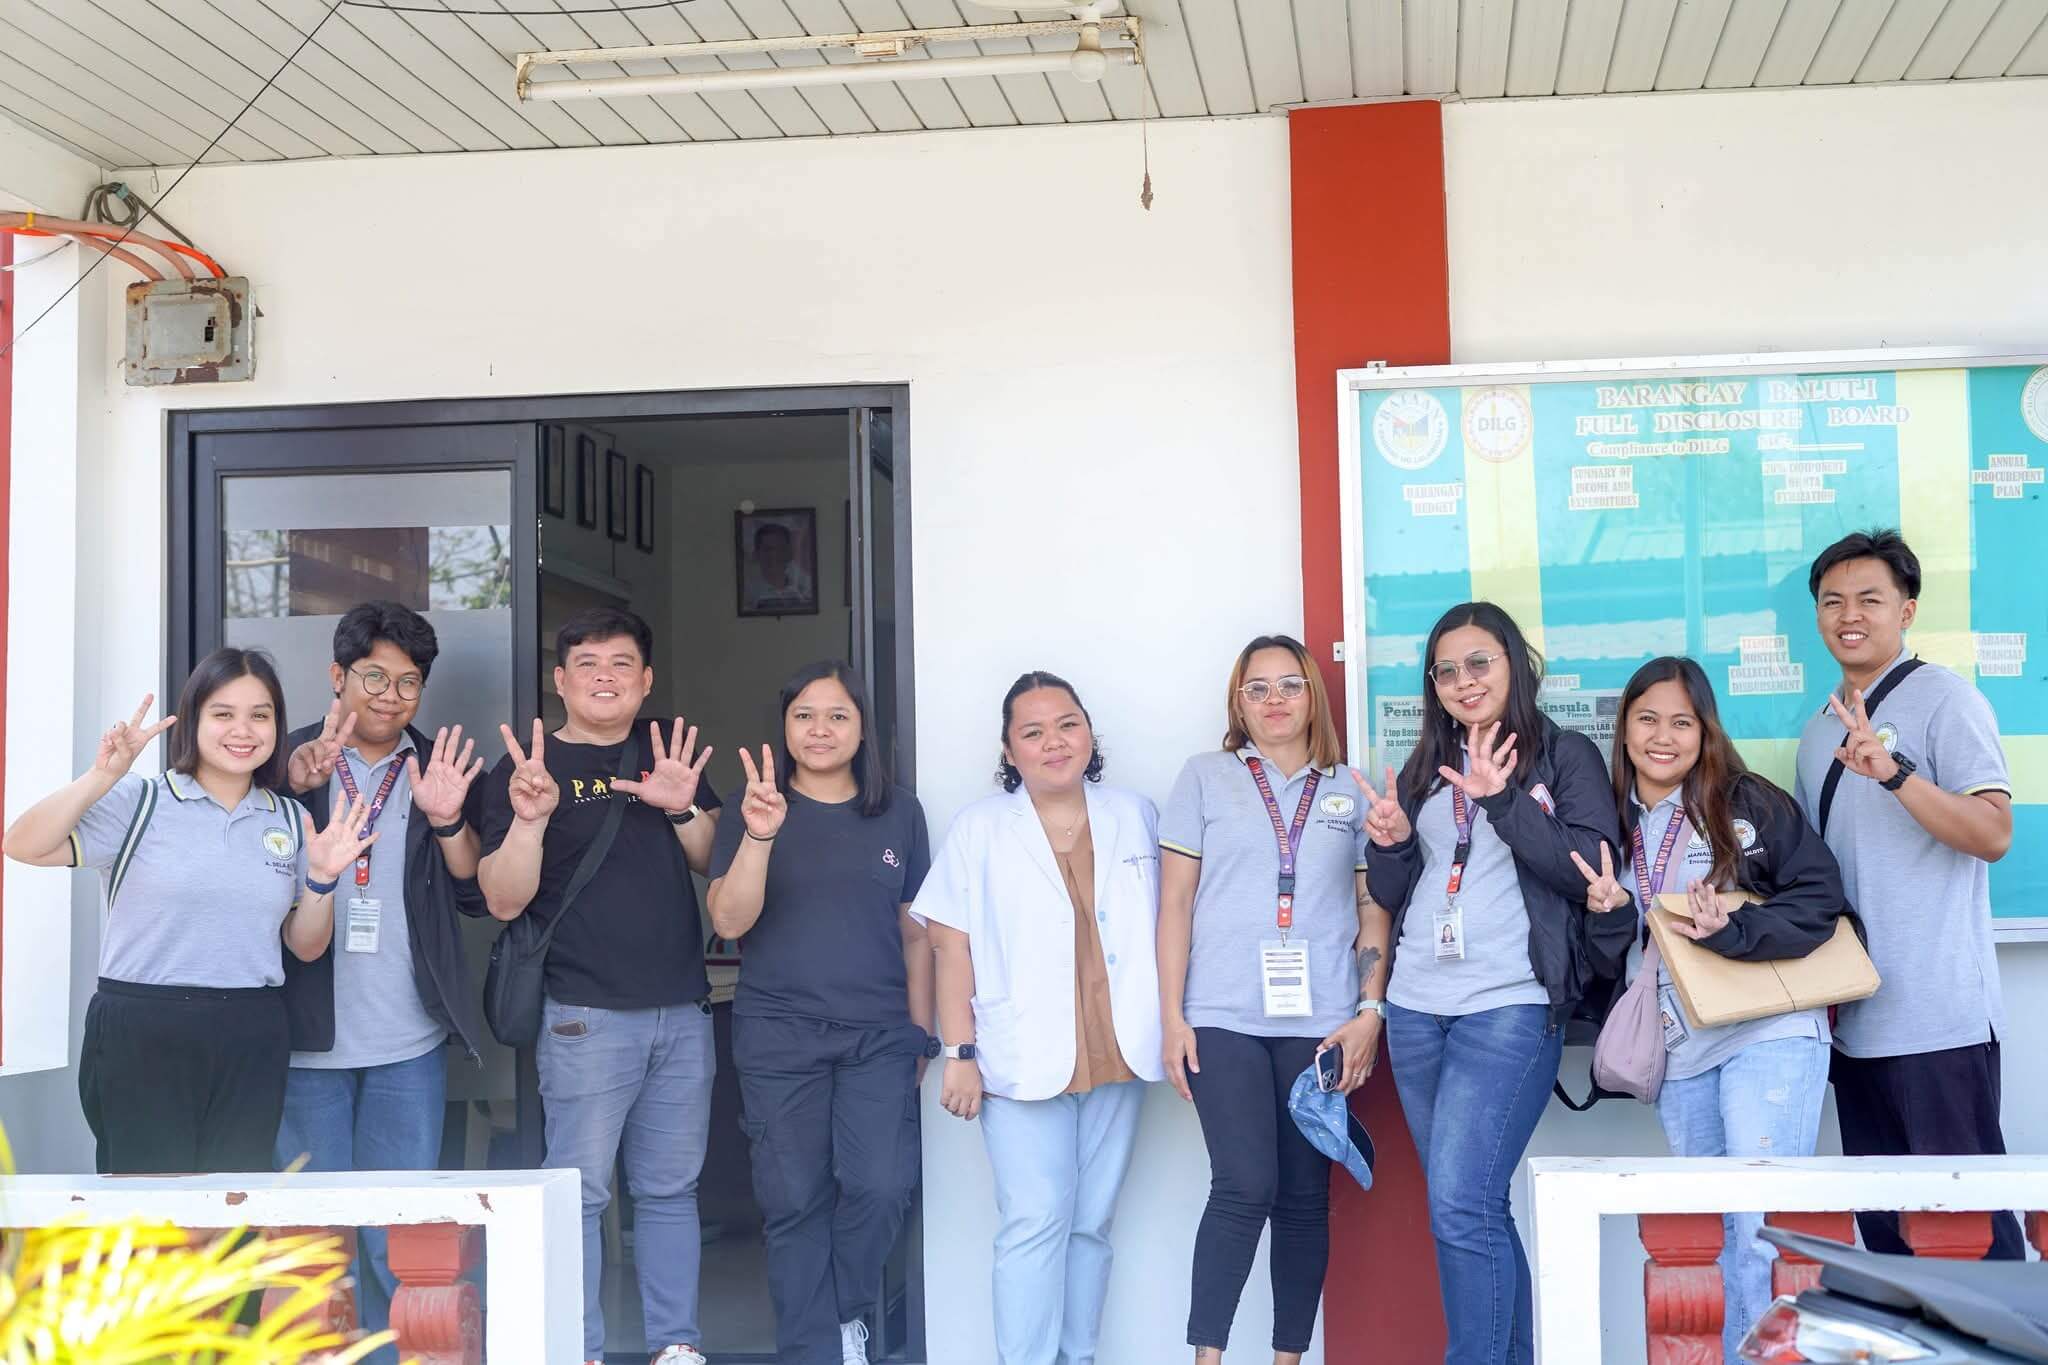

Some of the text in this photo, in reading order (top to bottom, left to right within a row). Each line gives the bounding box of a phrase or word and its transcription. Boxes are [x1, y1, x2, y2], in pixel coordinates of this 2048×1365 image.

[1599, 383, 1746, 407] BARANGAY
[1478, 416, 1517, 432] DILG
[1577, 406, 1911, 433] FULL DISCLOSURE BOARD
[1589, 439, 1728, 457] Compliance to DILG
[1991, 456, 2026, 467] ANNUAL
[1574, 466, 1631, 479] SUMMARY OF
[1974, 470, 2042, 482] PROCUREMENT
[1576, 480, 1631, 493] INCOME AND
[1996, 486, 2021, 497] PLAN
[1384, 706, 1424, 717] Penin
[1543, 702, 1590, 713] insula
[1389, 728, 1400, 737] top
[1250, 767, 1291, 854] MUNICIPAL HEALTH
[1655, 833, 1676, 873] BATAAN
